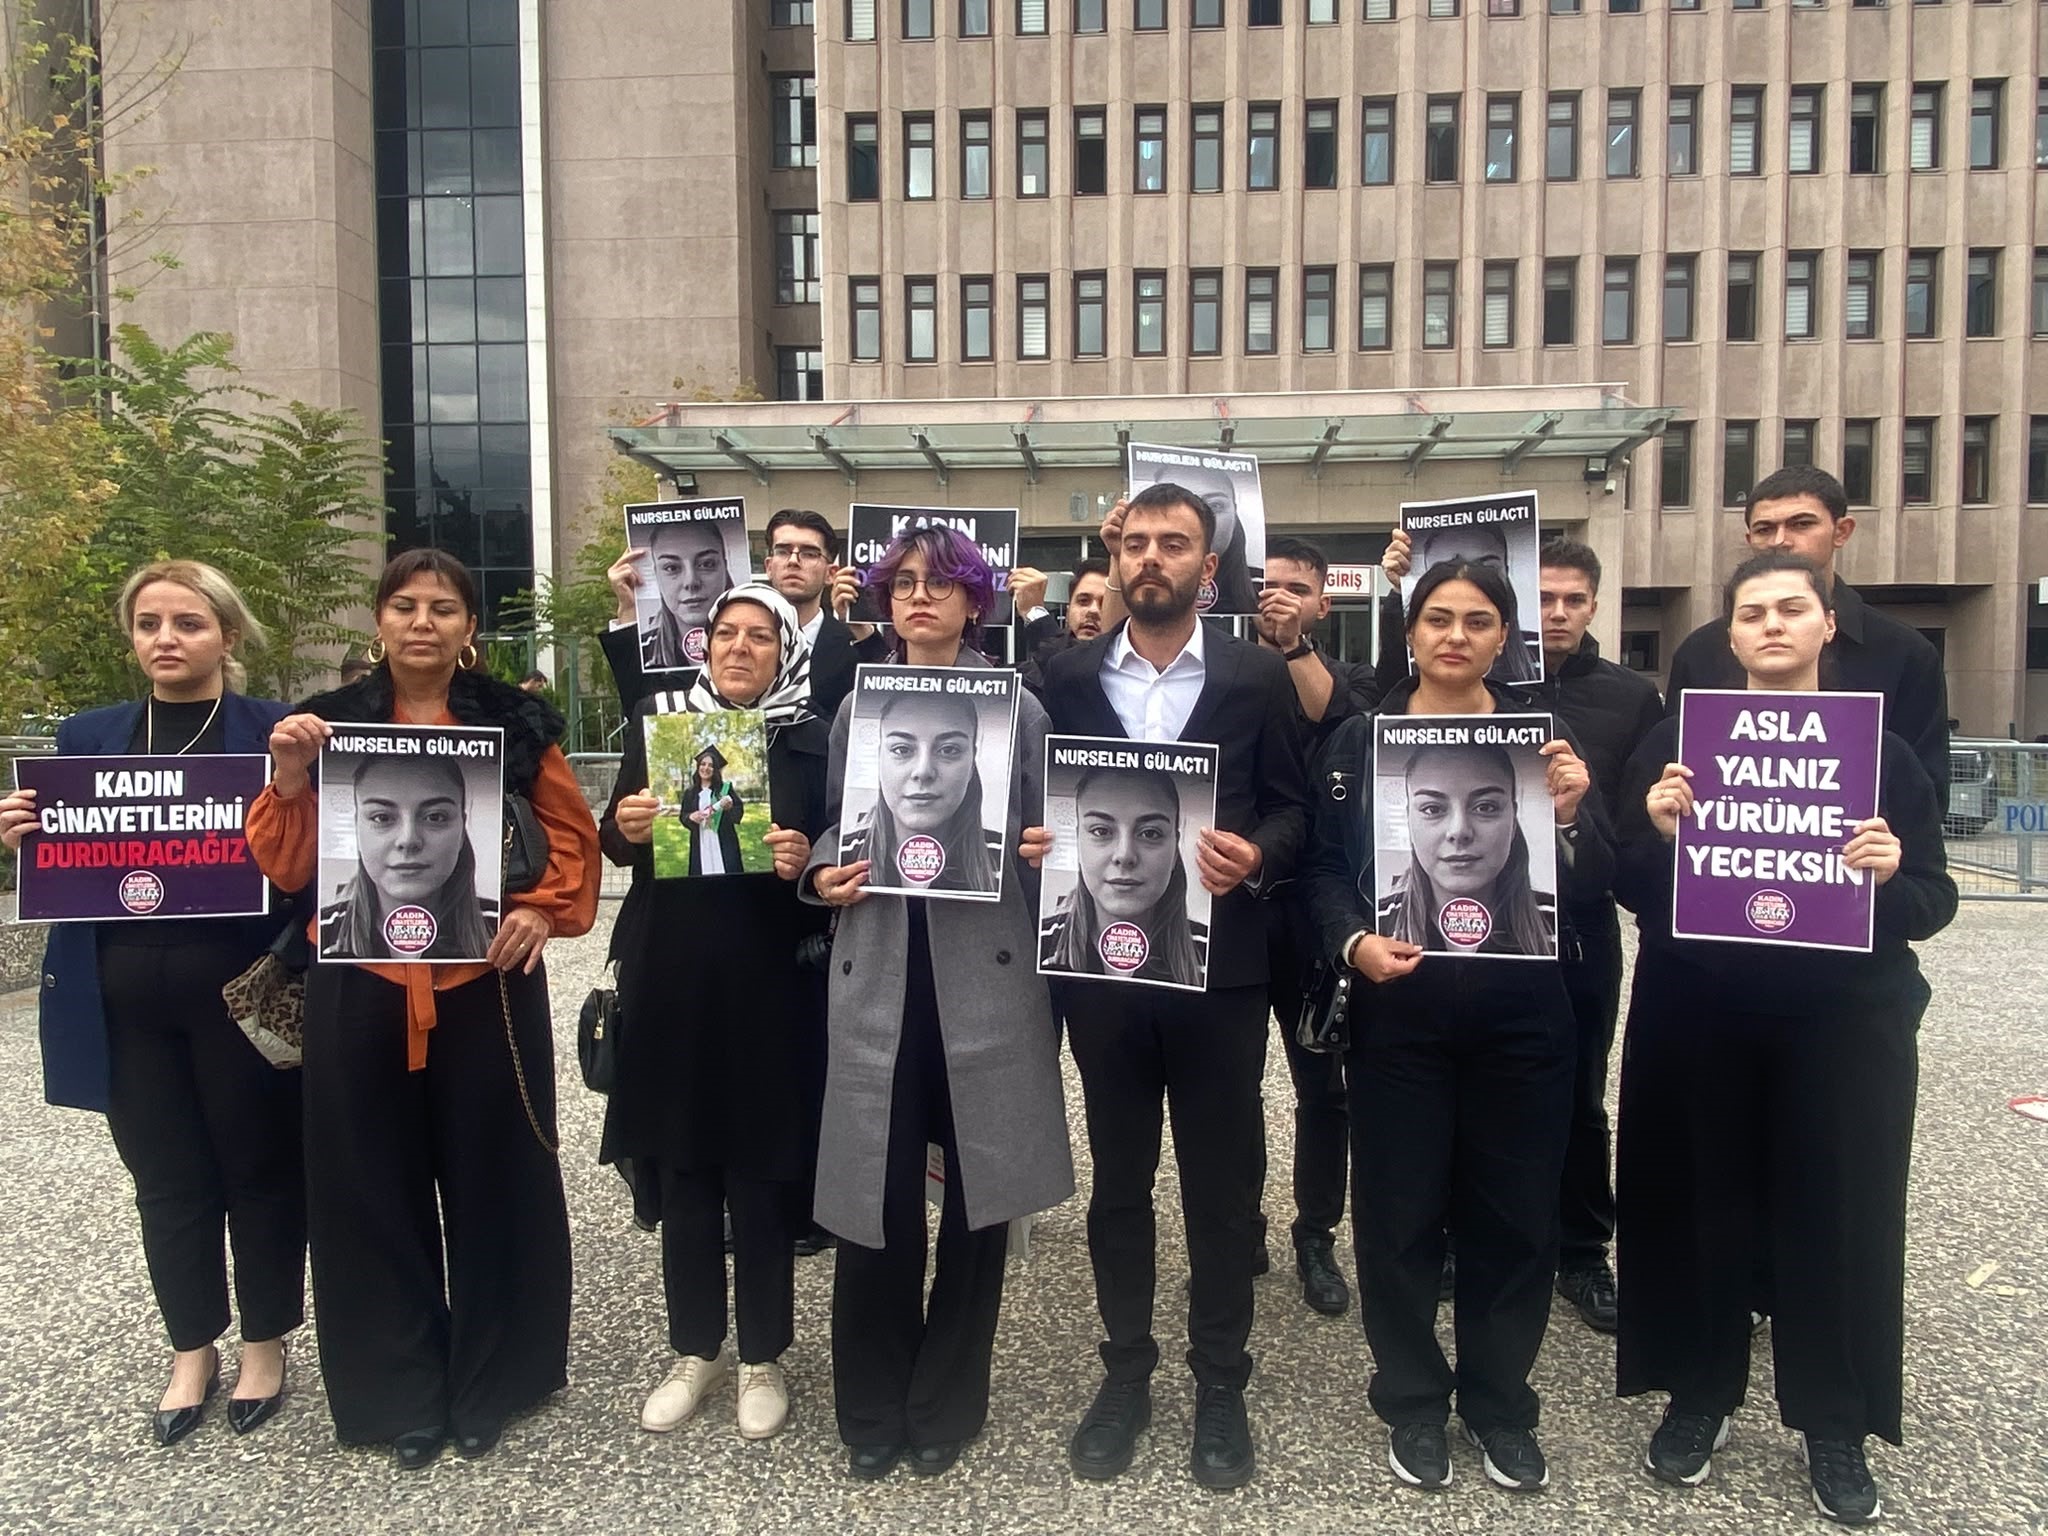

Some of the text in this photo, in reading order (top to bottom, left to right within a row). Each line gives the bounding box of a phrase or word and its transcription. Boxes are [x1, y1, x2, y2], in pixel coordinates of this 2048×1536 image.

[1135, 450, 1201, 467] NURSELEN
[631, 506, 740, 525] NURSELEN GÜLAÇTI
[1406, 505, 1529, 530] NURSELEN GÜLAÇTI
[1326, 570, 1362, 591] GİRİŞ
[863, 675, 1007, 696] NURSELEN GÜLAÇTI
[1382, 725, 1546, 747] NURSELEN GÜLAÇTI
[1729, 709, 1828, 743] ASLA
[329, 736, 495, 758] NURSELEN GÜLAÇTI
[1054, 748, 1209, 776] NURSELEN GÜLAÇTI
[1714, 755, 1841, 791] YALNIZ
[95, 770, 184, 798] KADIN
[40, 796, 243, 834] CİNAYETLERİNİ
[1692, 795, 1864, 838] YÜRÜME-
[36, 831, 247, 869] DURDURACAĞIZ
[1685, 845, 1864, 886] YECEKSİN
